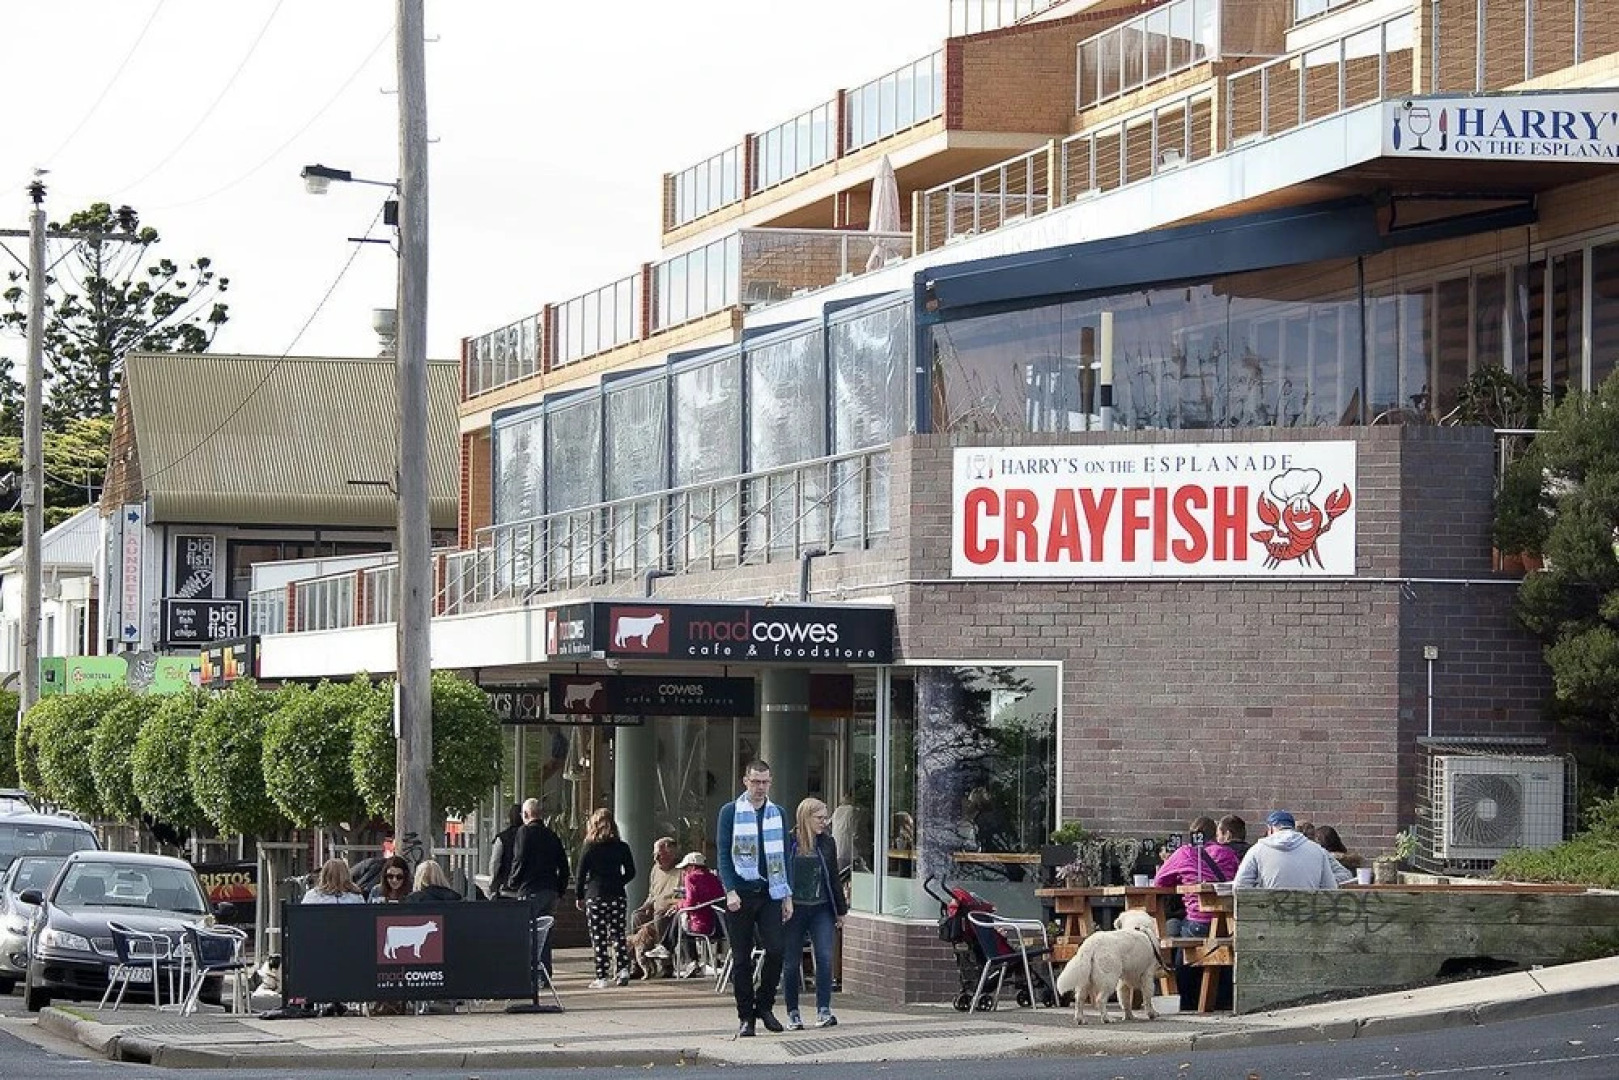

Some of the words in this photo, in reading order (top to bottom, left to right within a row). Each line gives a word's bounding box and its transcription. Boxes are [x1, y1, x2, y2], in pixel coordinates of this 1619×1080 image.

[1455, 140, 1481, 153] ON
[1487, 141, 1525, 155] THE
[1001, 457, 1078, 475] HARRY'S
[1085, 460, 1105, 474] ON
[1109, 460, 1136, 474] THE
[1144, 454, 1293, 472] ESPLANADE
[963, 484, 1249, 564] CRAYFISH
[187, 539, 212, 553] big
[186, 551, 212, 566] fish
[208, 606, 238, 625] big
[175, 629, 197, 638] chips
[207, 622, 238, 638] fish
[688, 642, 732, 656] cafe
[747, 644, 758, 656] &
[775, 644, 875, 658] foodstore
[1192, 832, 1204, 843] 12
